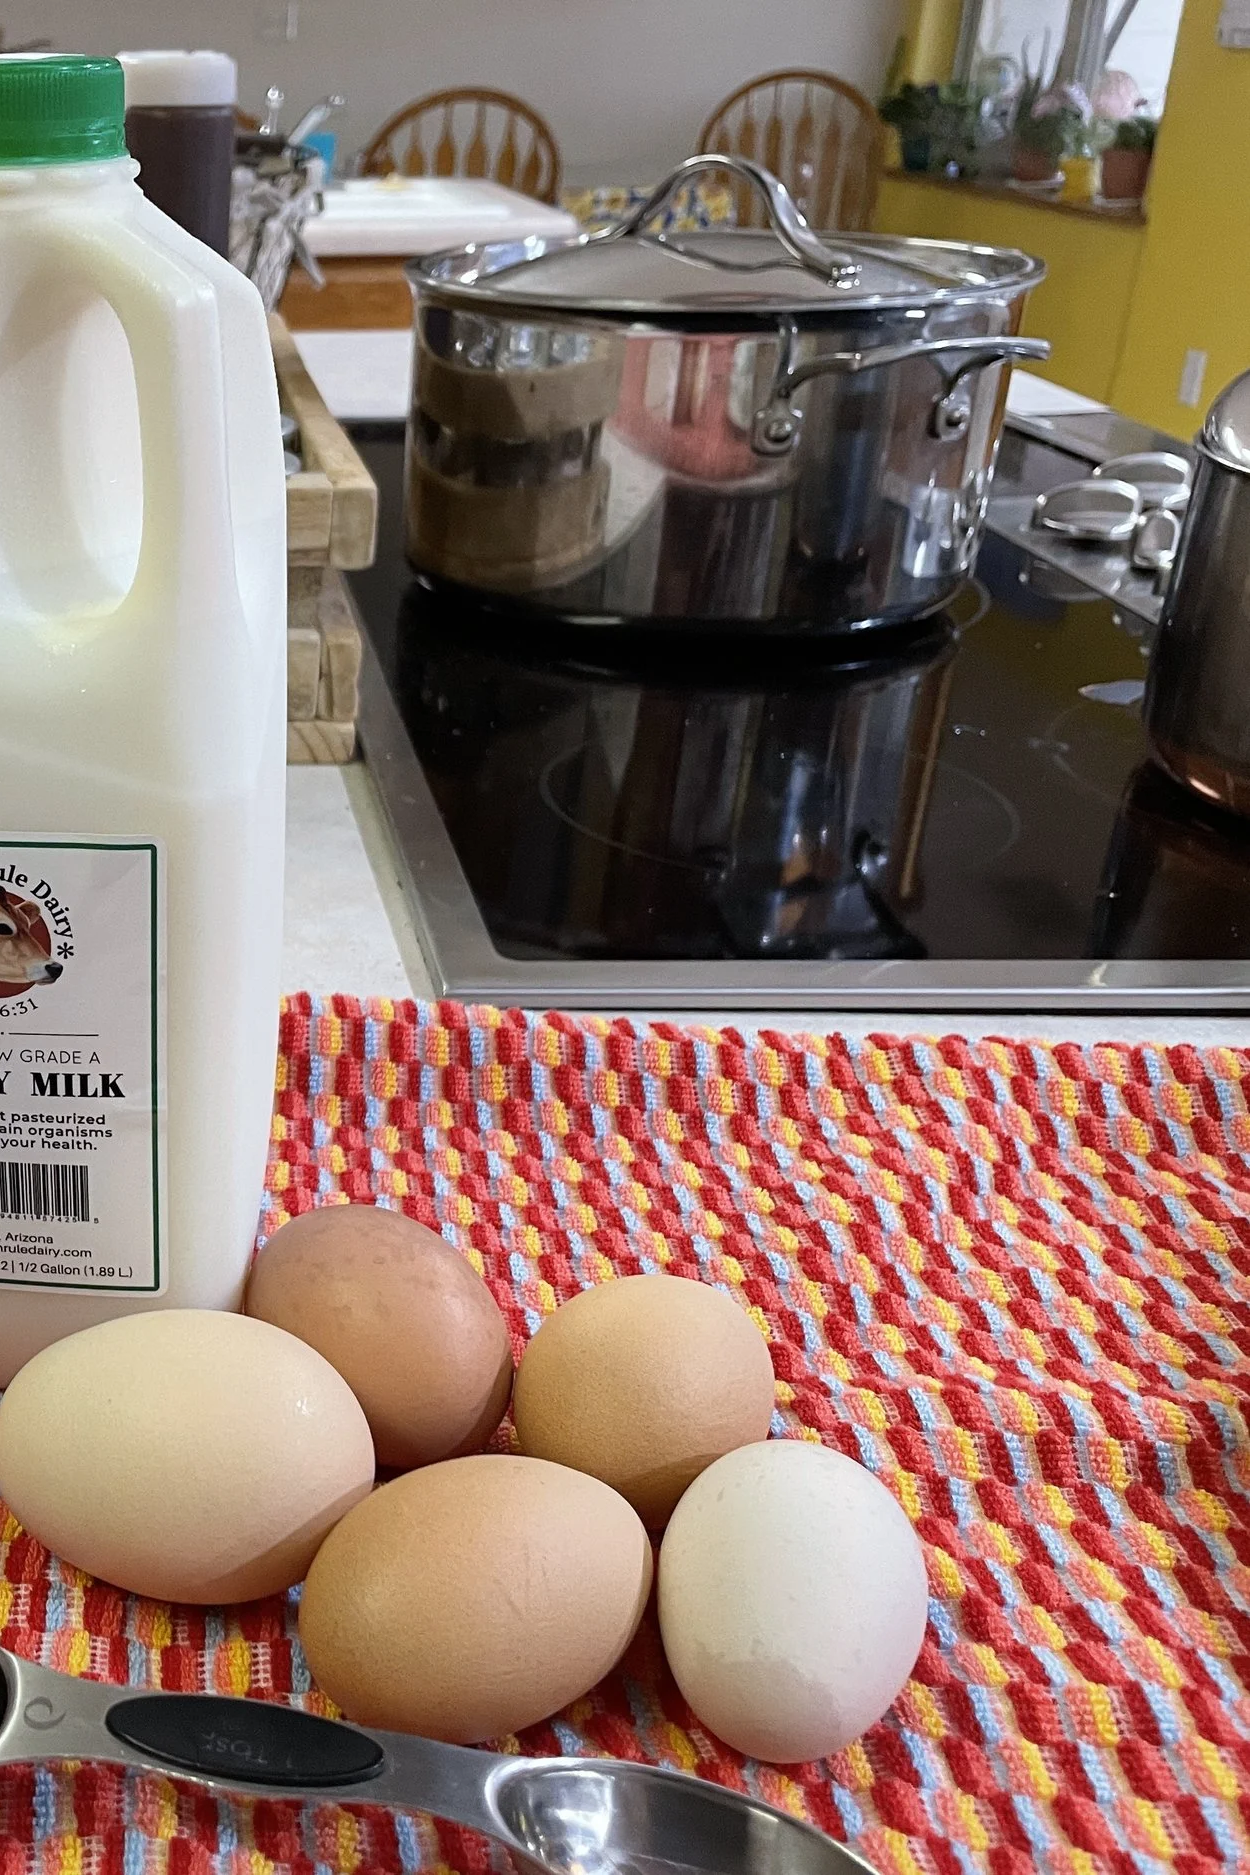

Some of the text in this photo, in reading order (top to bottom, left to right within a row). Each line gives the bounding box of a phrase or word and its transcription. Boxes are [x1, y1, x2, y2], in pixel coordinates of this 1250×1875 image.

[30, 879, 74, 939] Dairy
[0, 998, 39, 1017] 6:31
[20, 1049, 82, 1064] GRADE
[89, 1052, 101, 1064] A
[30, 1072, 126, 1098] MILK
[11, 1113, 105, 1125] pasteurized
[28, 1126, 112, 1138] organisms
[0, 1138, 36, 1149] your
[41, 1138, 97, 1150] health.
[5, 1232, 54, 1244] Arizona
[19, 1262, 37, 1273] 1/2
[40, 1264, 80, 1276] Gallon
[84, 1265, 114, 1277] (1.89
[118, 1266, 133, 1278] L)
